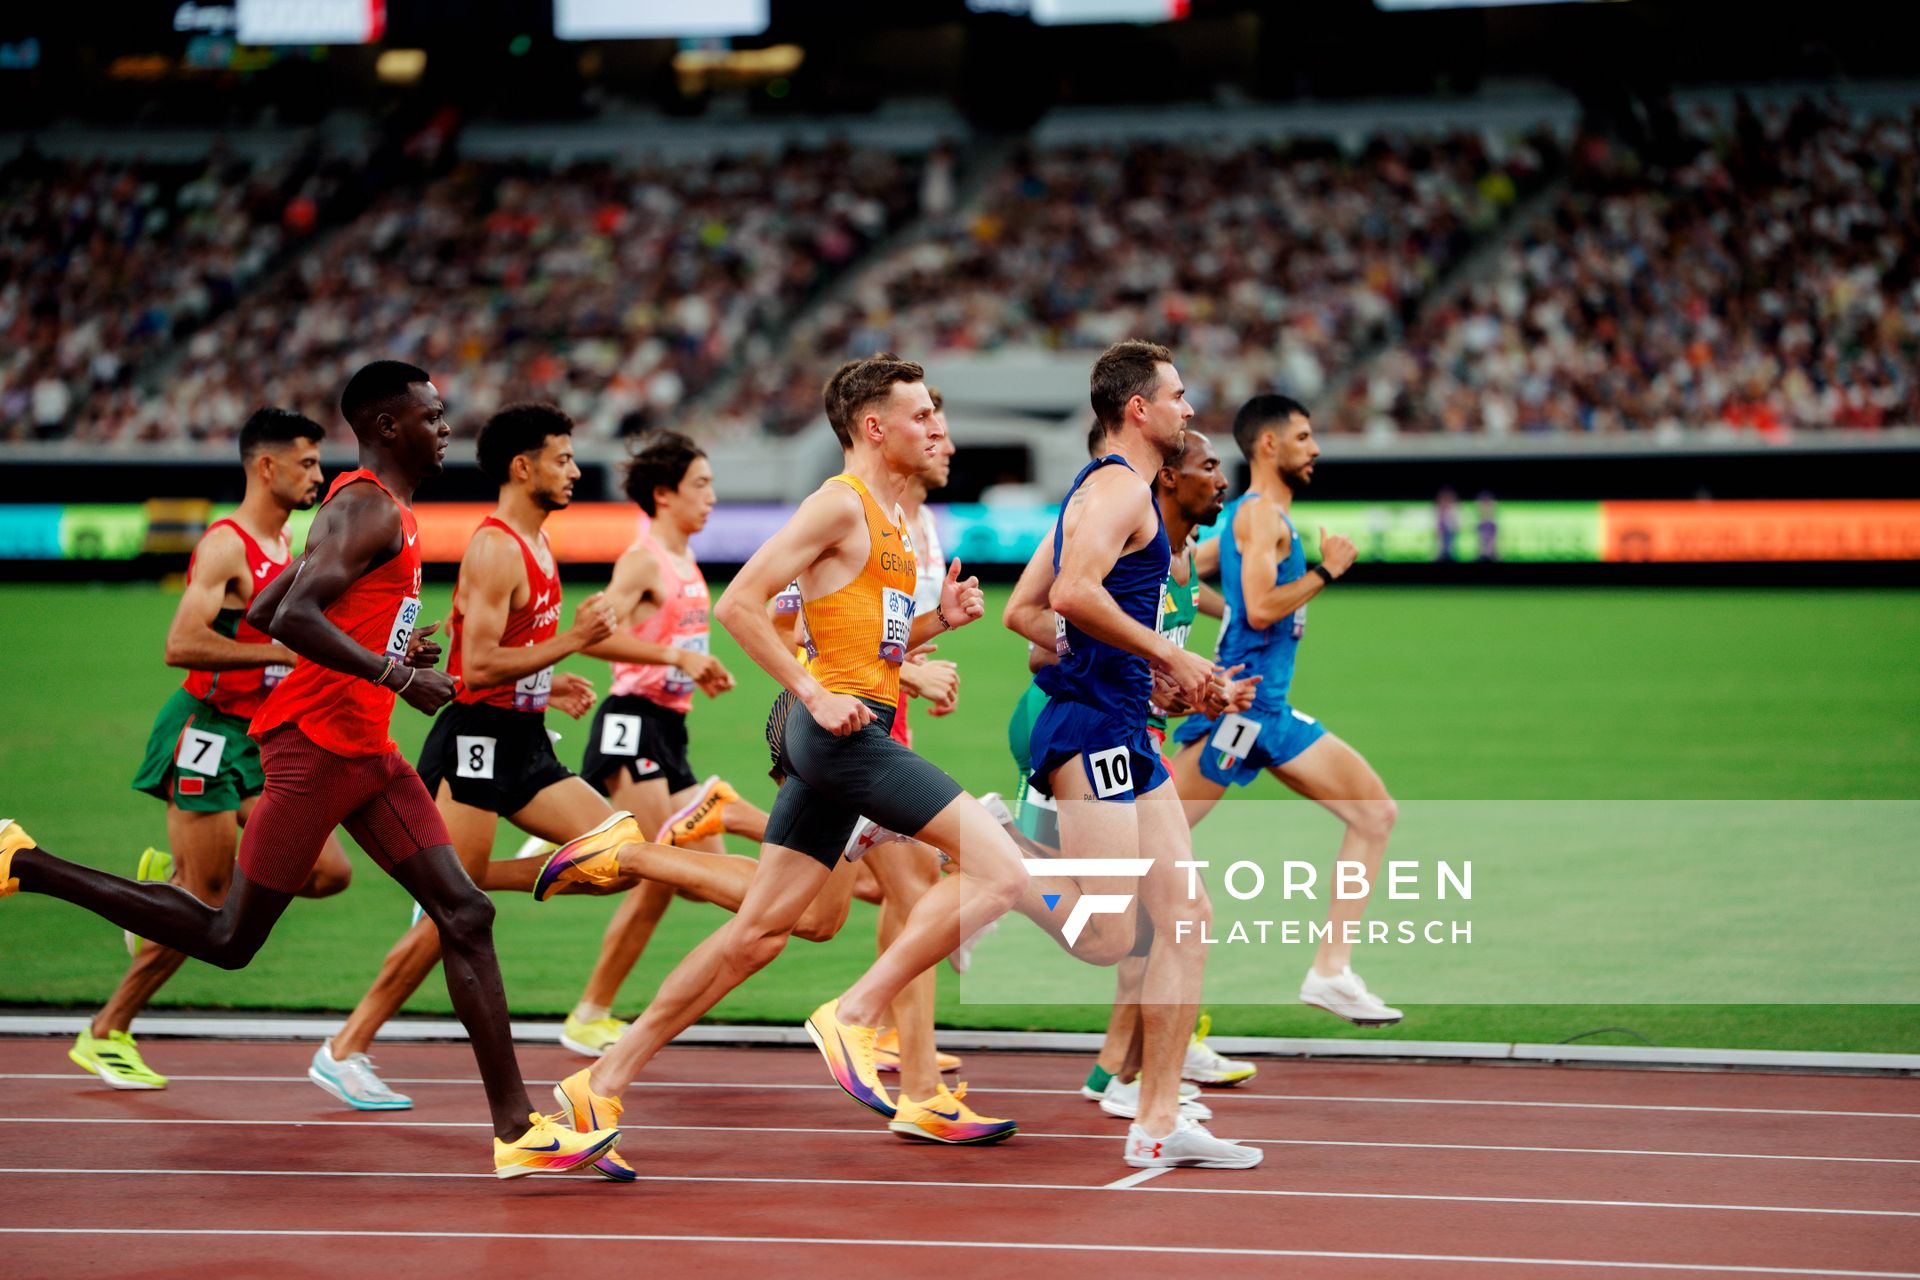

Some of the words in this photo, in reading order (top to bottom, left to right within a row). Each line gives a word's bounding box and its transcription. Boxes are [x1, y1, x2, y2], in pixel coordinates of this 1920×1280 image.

[615, 722, 627, 748] 2
[1231, 724, 1245, 748] 1
[192, 738, 212, 764] 7
[469, 744, 484, 771] 8
[1095, 753, 1129, 790] 10
